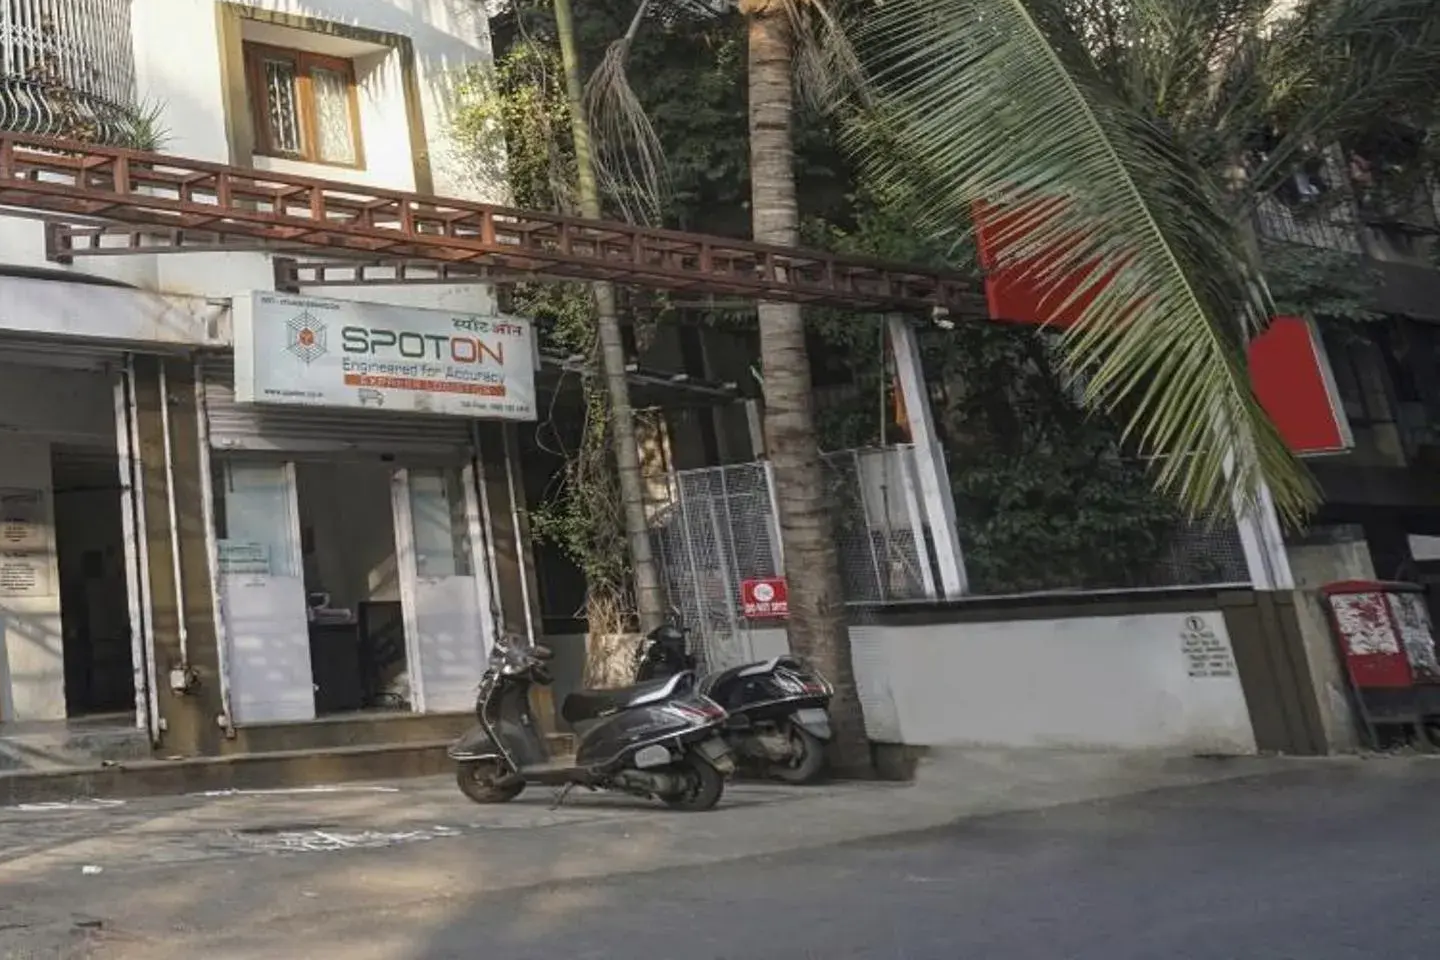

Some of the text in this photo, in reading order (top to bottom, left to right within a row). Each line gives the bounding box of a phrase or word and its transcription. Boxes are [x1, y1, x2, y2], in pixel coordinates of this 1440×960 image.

[341, 326, 504, 366] SPOTON
[342, 357, 505, 385] Engineered for Accuracy
